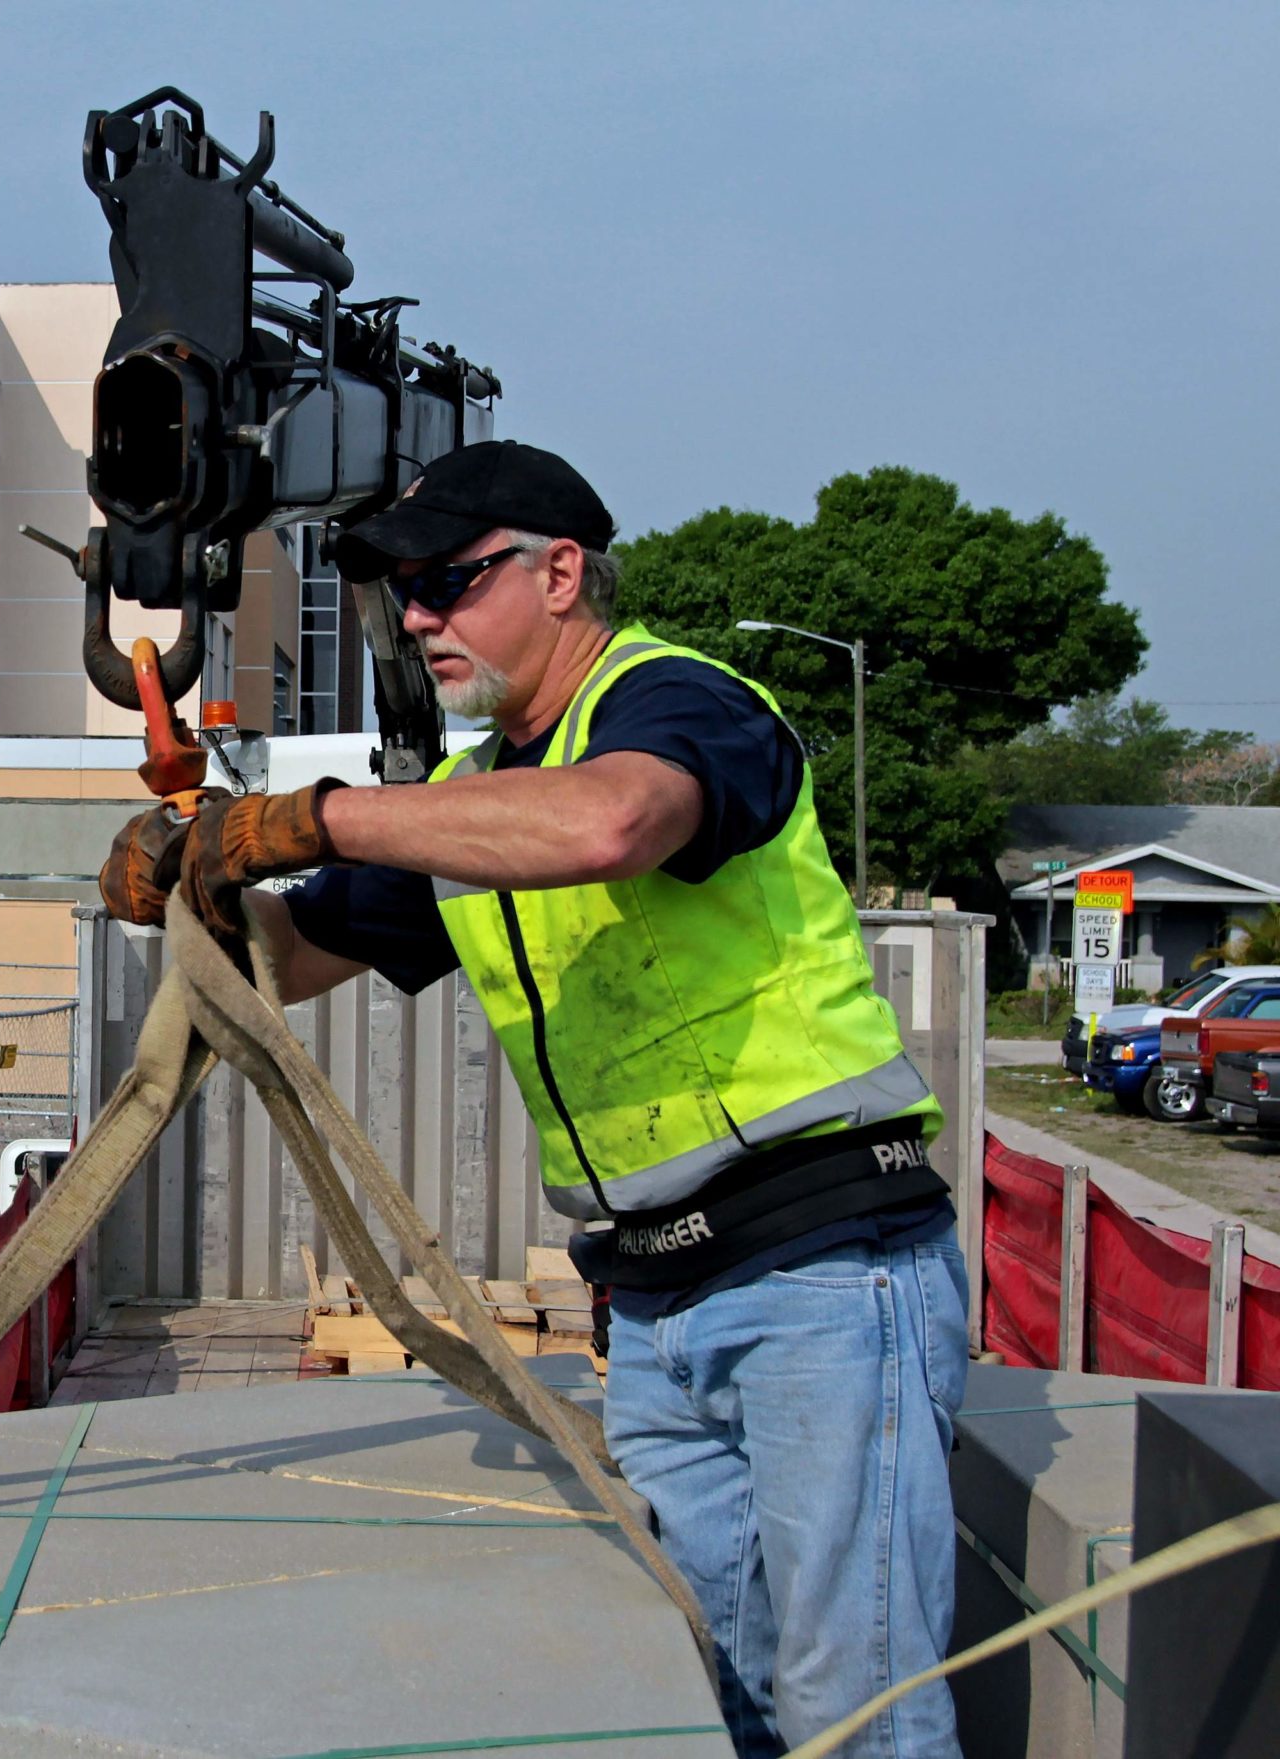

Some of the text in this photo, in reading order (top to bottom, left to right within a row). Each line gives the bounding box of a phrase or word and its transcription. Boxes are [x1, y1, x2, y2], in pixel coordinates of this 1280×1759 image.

[1083, 876, 1128, 886] DETOUR
[1078, 894, 1119, 905] SCHOOL
[1078, 914, 1117, 925] SPEED
[1082, 927, 1112, 936] LIMIT
[1084, 938, 1110, 958] 15
[1082, 968, 1108, 978] SCHOOL
[618, 1211, 714, 1255] PALFINGER
